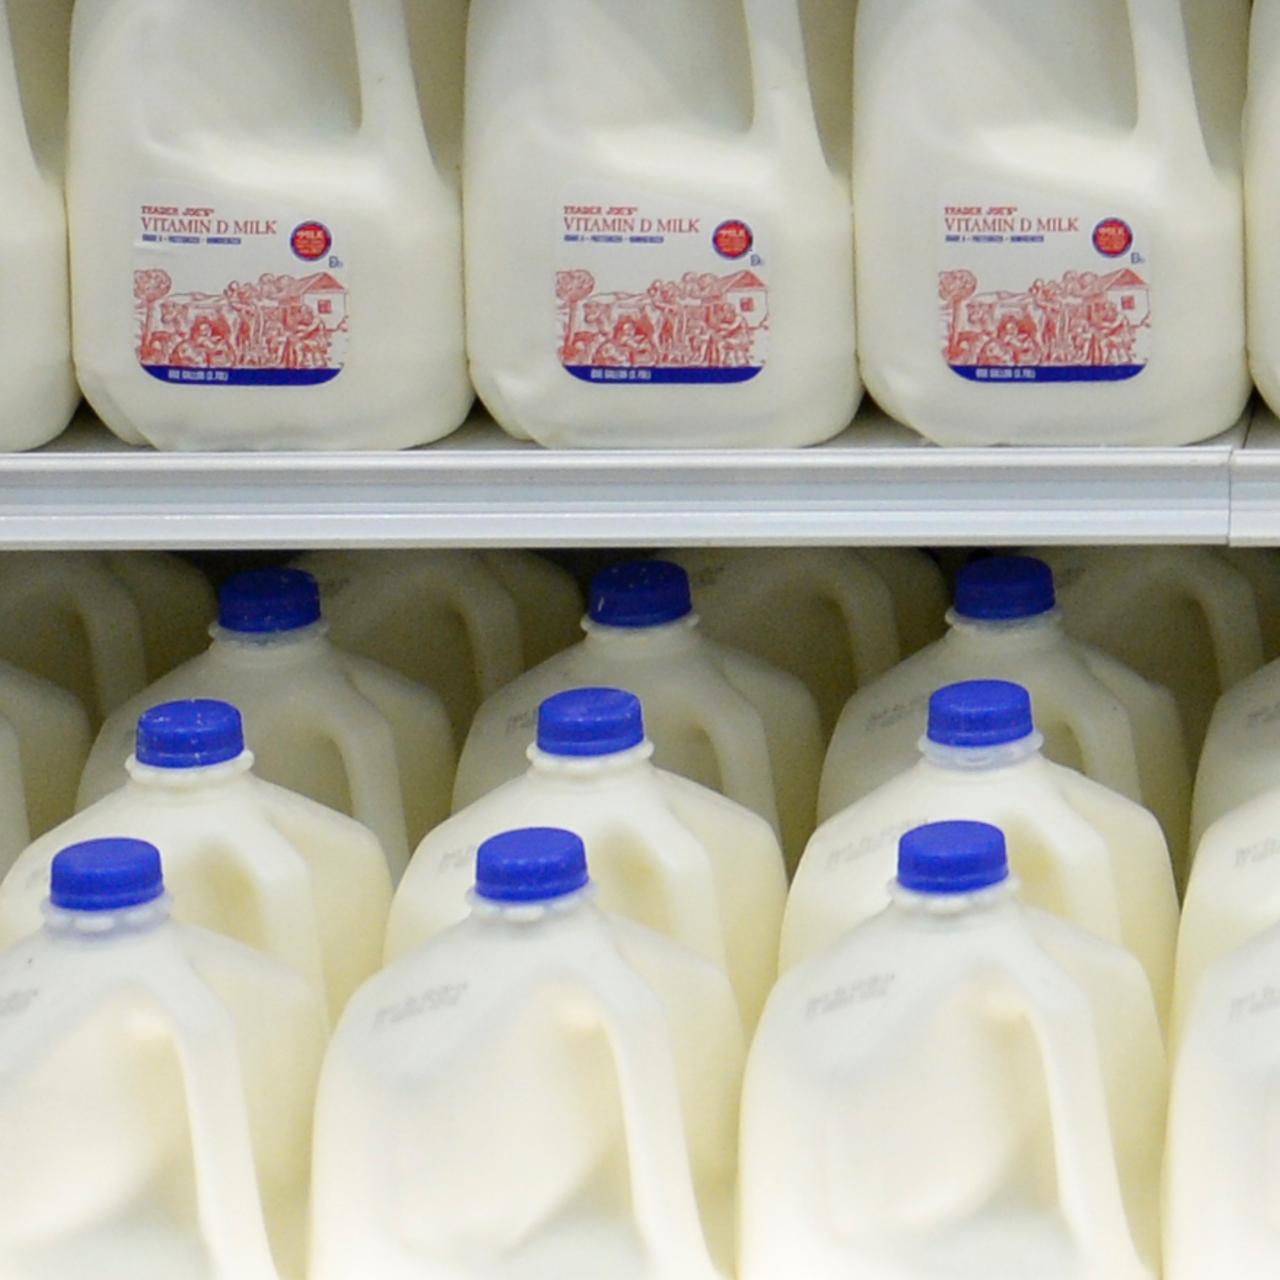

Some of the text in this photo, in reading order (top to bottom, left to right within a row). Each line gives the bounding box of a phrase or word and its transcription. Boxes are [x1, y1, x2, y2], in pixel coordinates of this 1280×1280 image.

[141, 206, 180, 216] TRADER
[140, 218, 278, 235] VITAMIN D MILK
